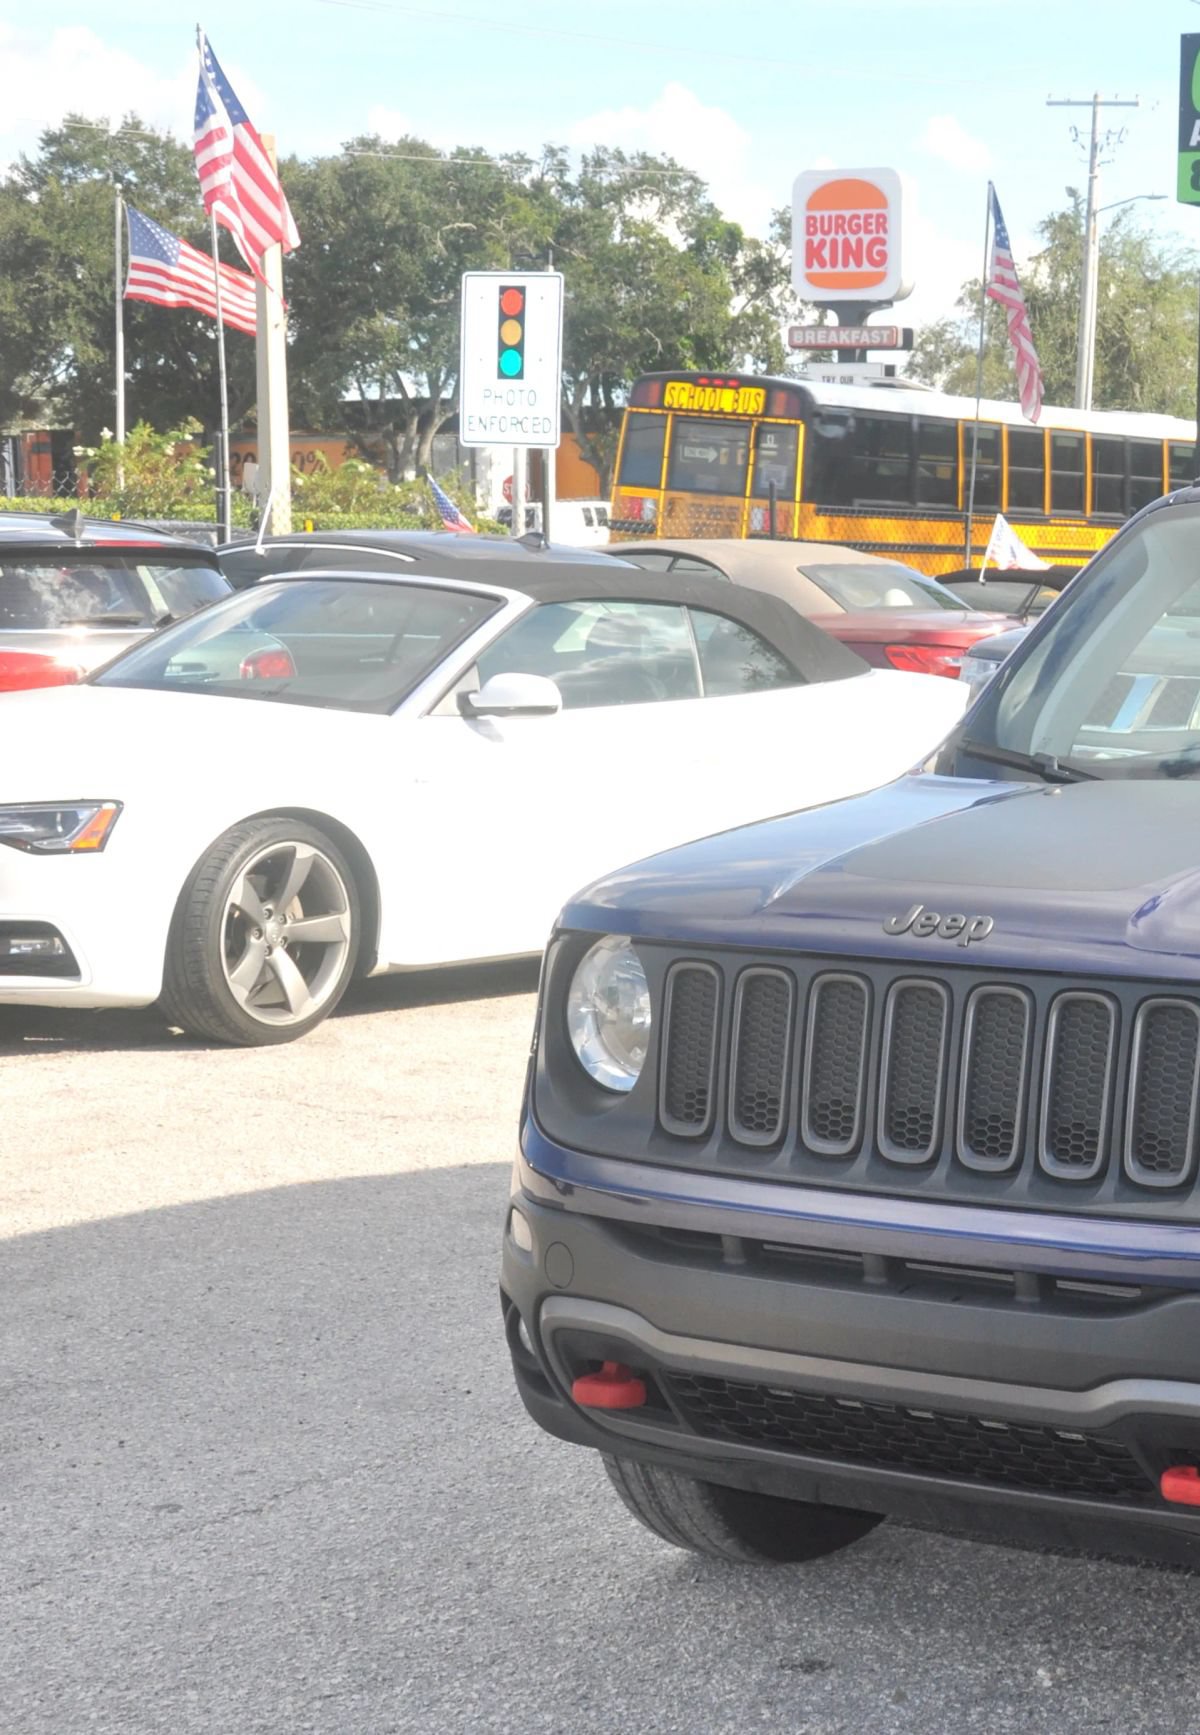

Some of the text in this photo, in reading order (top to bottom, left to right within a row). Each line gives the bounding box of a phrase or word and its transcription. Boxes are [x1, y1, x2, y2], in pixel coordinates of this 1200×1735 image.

[805, 212, 888, 237] BURGER
[805, 236, 888, 269] KING
[793, 329, 891, 345] BREAKFAST
[482, 388, 538, 407] PHOTO
[665, 385, 762, 415] SCHOOL BUS
[467, 415, 553, 434] ENFORCED
[882, 904, 995, 948] Jeep
